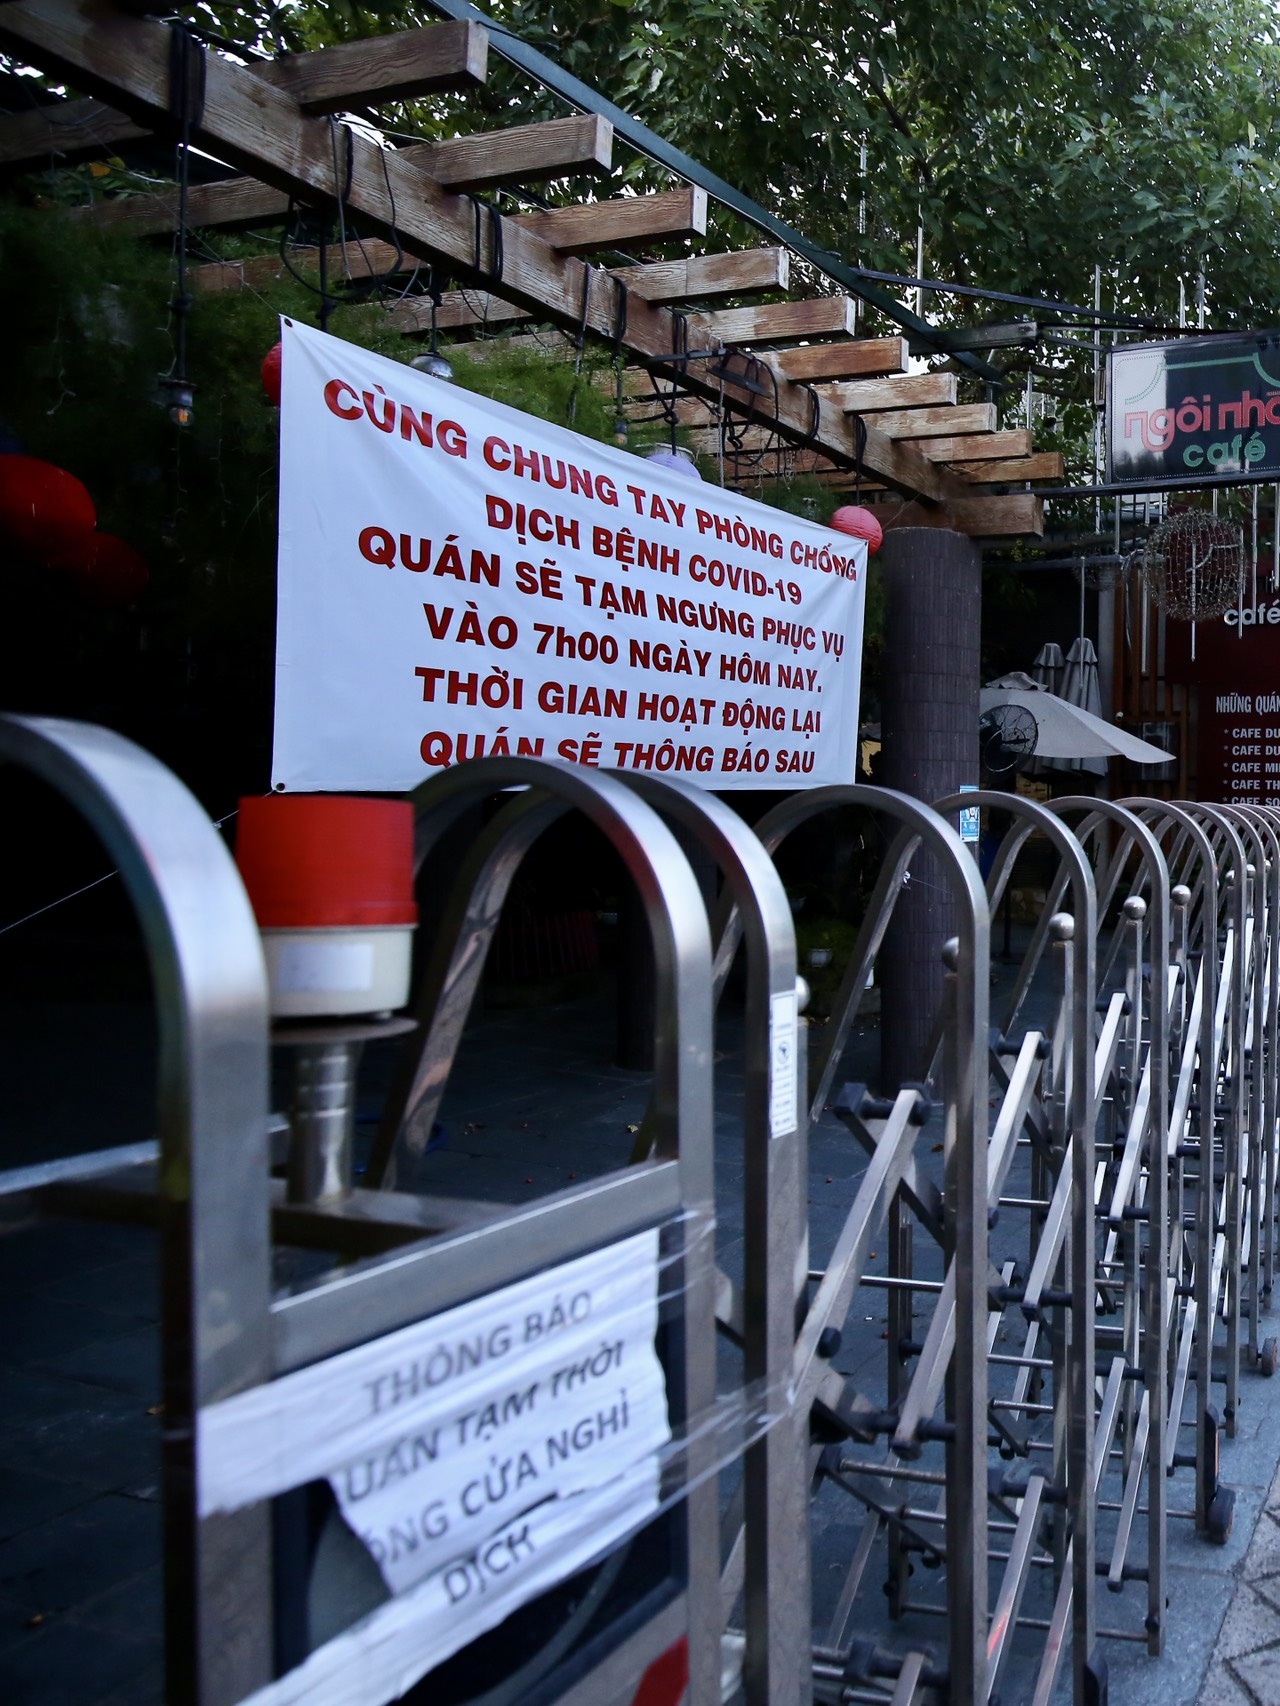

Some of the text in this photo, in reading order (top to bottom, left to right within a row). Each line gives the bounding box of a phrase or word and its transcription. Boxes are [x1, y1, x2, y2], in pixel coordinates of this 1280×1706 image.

[1124, 394, 1211, 451] ngôi
[1182, 431, 1267, 468] café
[324, 378, 857, 581] CÙNG CHUNG TAY PHÒNG CHỐNG
[485, 494, 802, 605] DỊCH BỆNH COVID-19
[358, 526, 845, 662] QUÁN SẼ TẠM NGƯNG PHỤC VỤ
[423, 600, 822, 693] VÀO 7h00 NGÀY HÔM NAY.
[415, 665, 821, 739] THỜI GIAN HOẠT ĐỘNG LẠI
[1216, 692, 1252, 713] NHỮNG
[1232, 728, 1261, 738] CAFE
[1265, 728, 1280, 738] DU
[420, 726, 815, 774] QUÁN SẼ THÔNG BÁO SAU
[1231, 779, 1260, 790] CAFE
[1232, 745, 1261, 756] CAFE
[1265, 745, 1280, 756] DU
[1232, 762, 1261, 773] CAFE
[361, 1290, 592, 1416] THÔNG BÁO
[343, 1338, 625, 1503] UÁN TẠM THỜI
[460, 1451, 539, 1517] CỬA
[546, 1386, 630, 1469] NGHỈ
[443, 1524, 537, 1603] DỊCH
